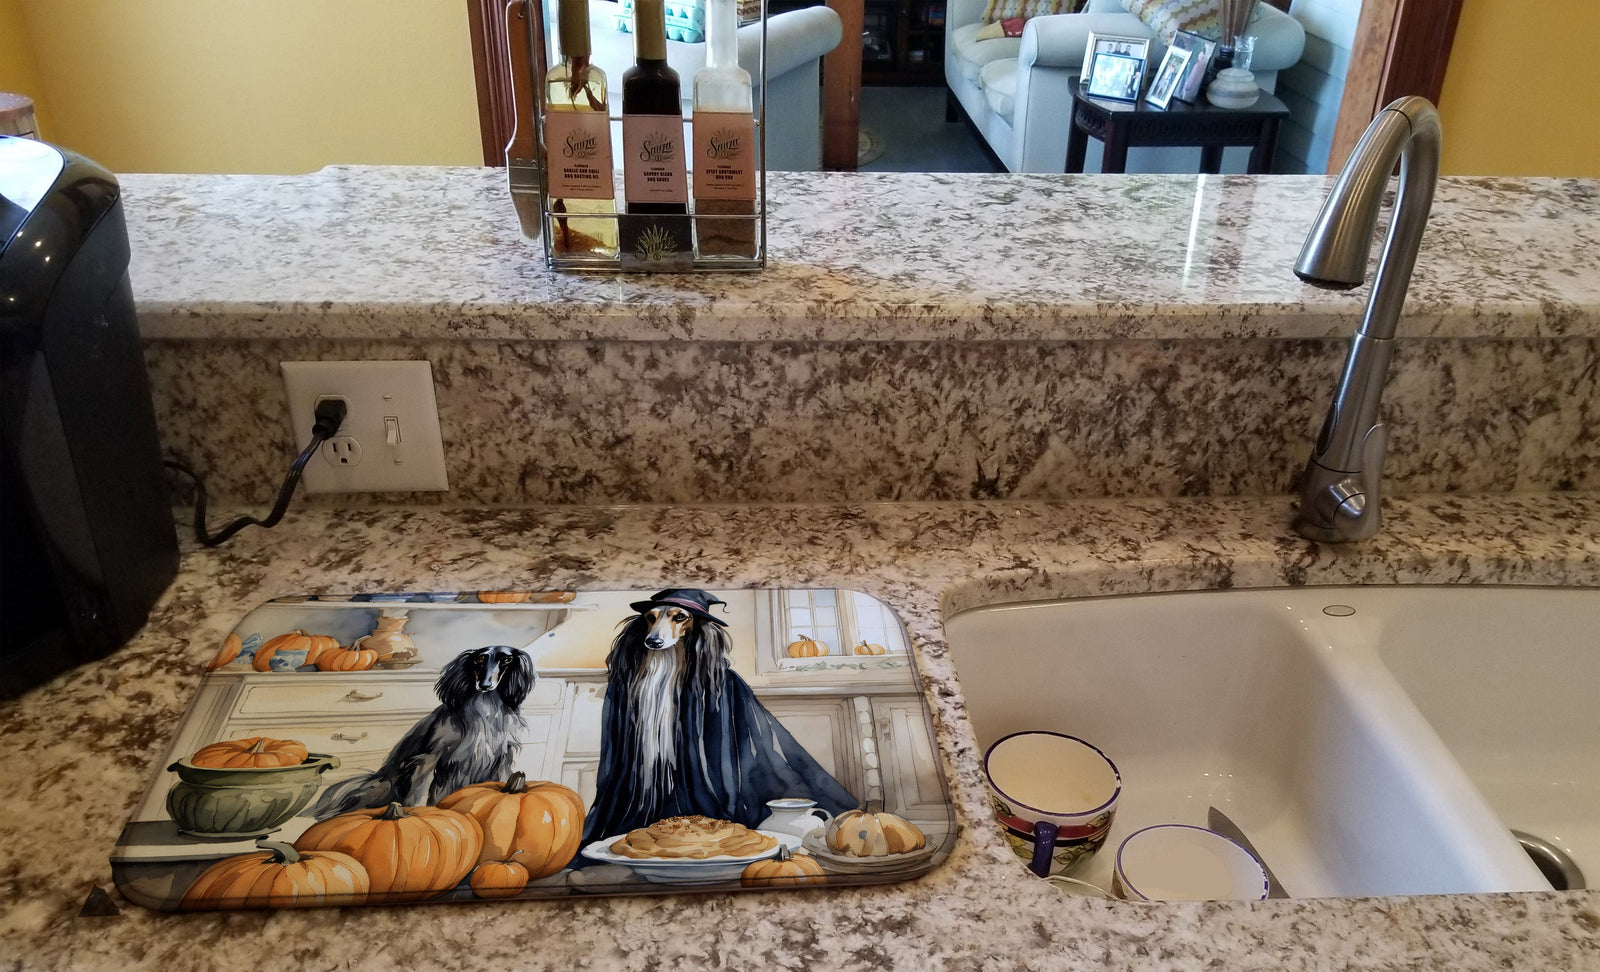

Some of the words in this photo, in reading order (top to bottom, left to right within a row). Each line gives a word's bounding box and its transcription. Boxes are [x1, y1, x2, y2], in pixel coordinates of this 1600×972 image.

[563, 136, 596, 158] Sauza
[639, 140, 673, 162] Sauza
[706, 137, 740, 159] Sauza
